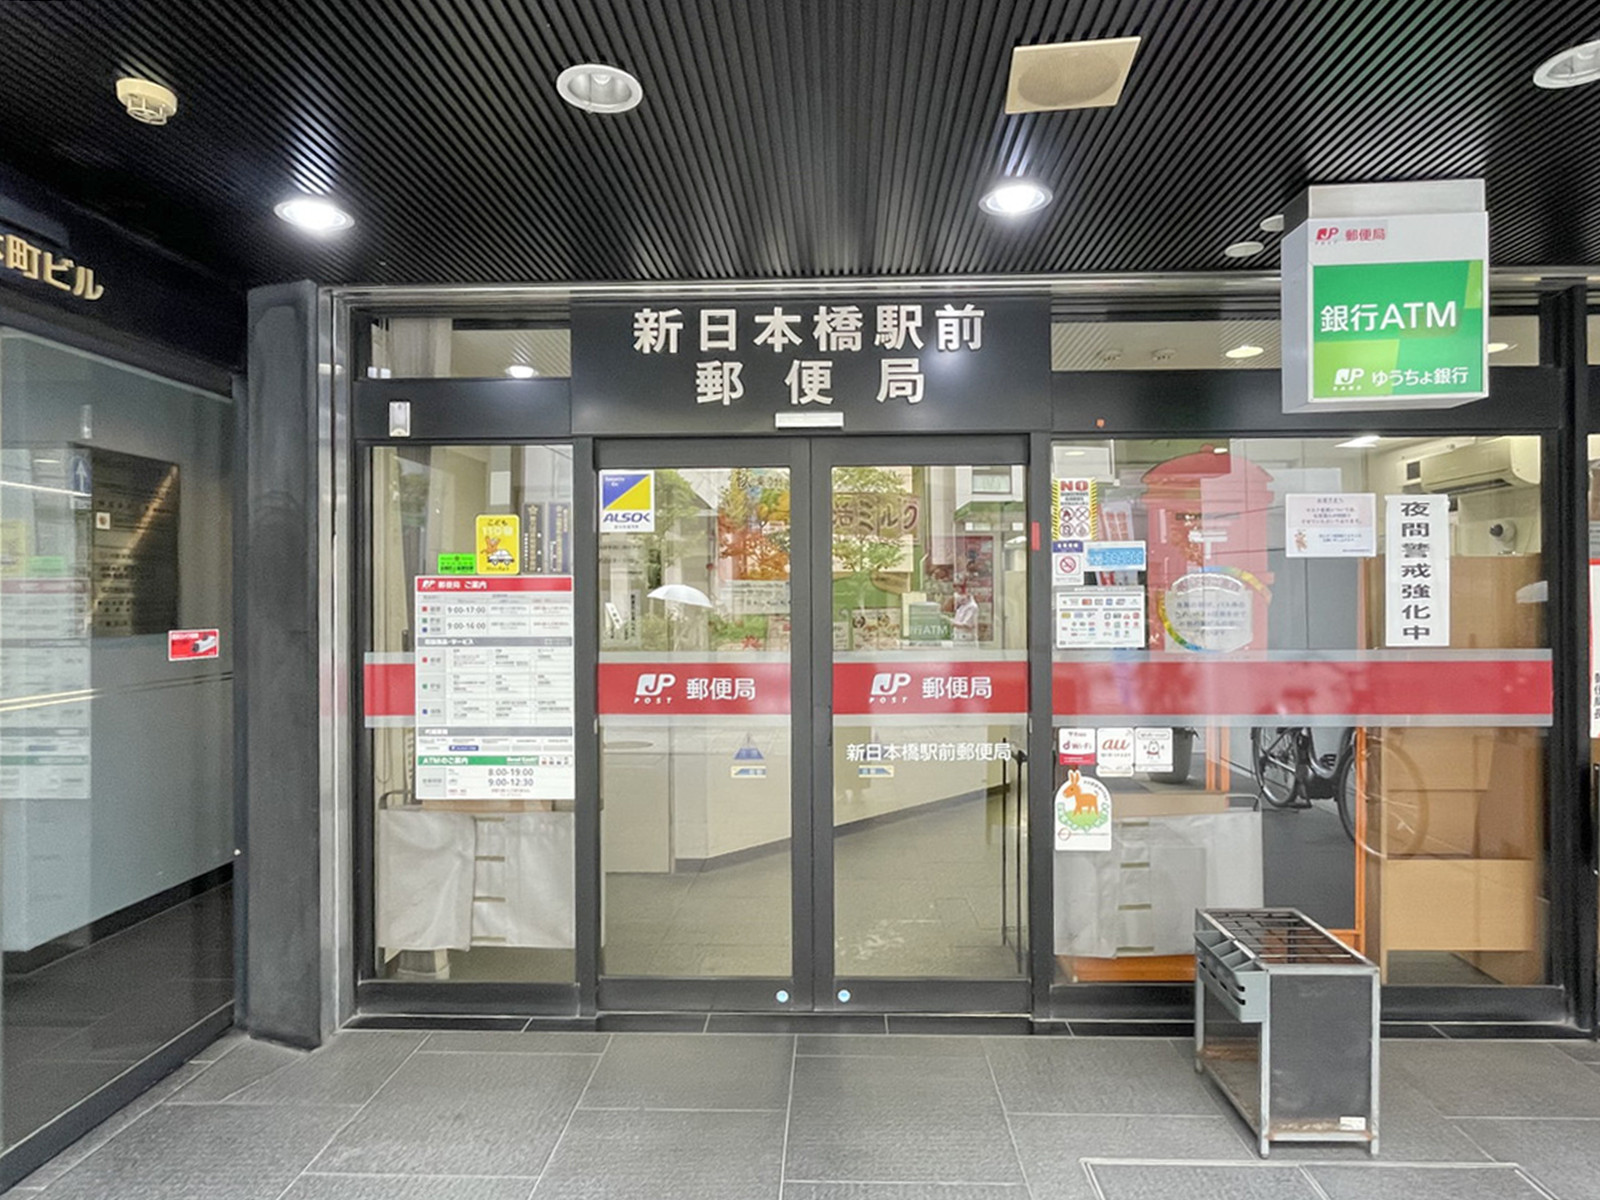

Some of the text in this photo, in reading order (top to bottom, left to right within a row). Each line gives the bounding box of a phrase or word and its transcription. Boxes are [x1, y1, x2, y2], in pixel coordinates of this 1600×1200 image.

[1345, 228, 1386, 241] 郵便局
[1320, 301, 1456, 333] 銀行ATM
[633, 303, 985, 354] 新日本橋駅前
[695, 357, 925, 406] 郵便局
[1372, 367, 1469, 387] ゆうちょ銀行
[1060, 480, 1088, 491] NO
[603, 512, 651, 523] ALSOK
[1400, 502, 1431, 640] 夜間警戒強化中
[636, 673, 756, 701] JP 郵便局
[871, 673, 993, 700] JP 郵便局
[633, 697, 672, 705] POST
[869, 696, 908, 704] POST
[846, 743, 1012, 762] 新日本橋駅前郵便局
[1102, 739, 1130, 751] au
